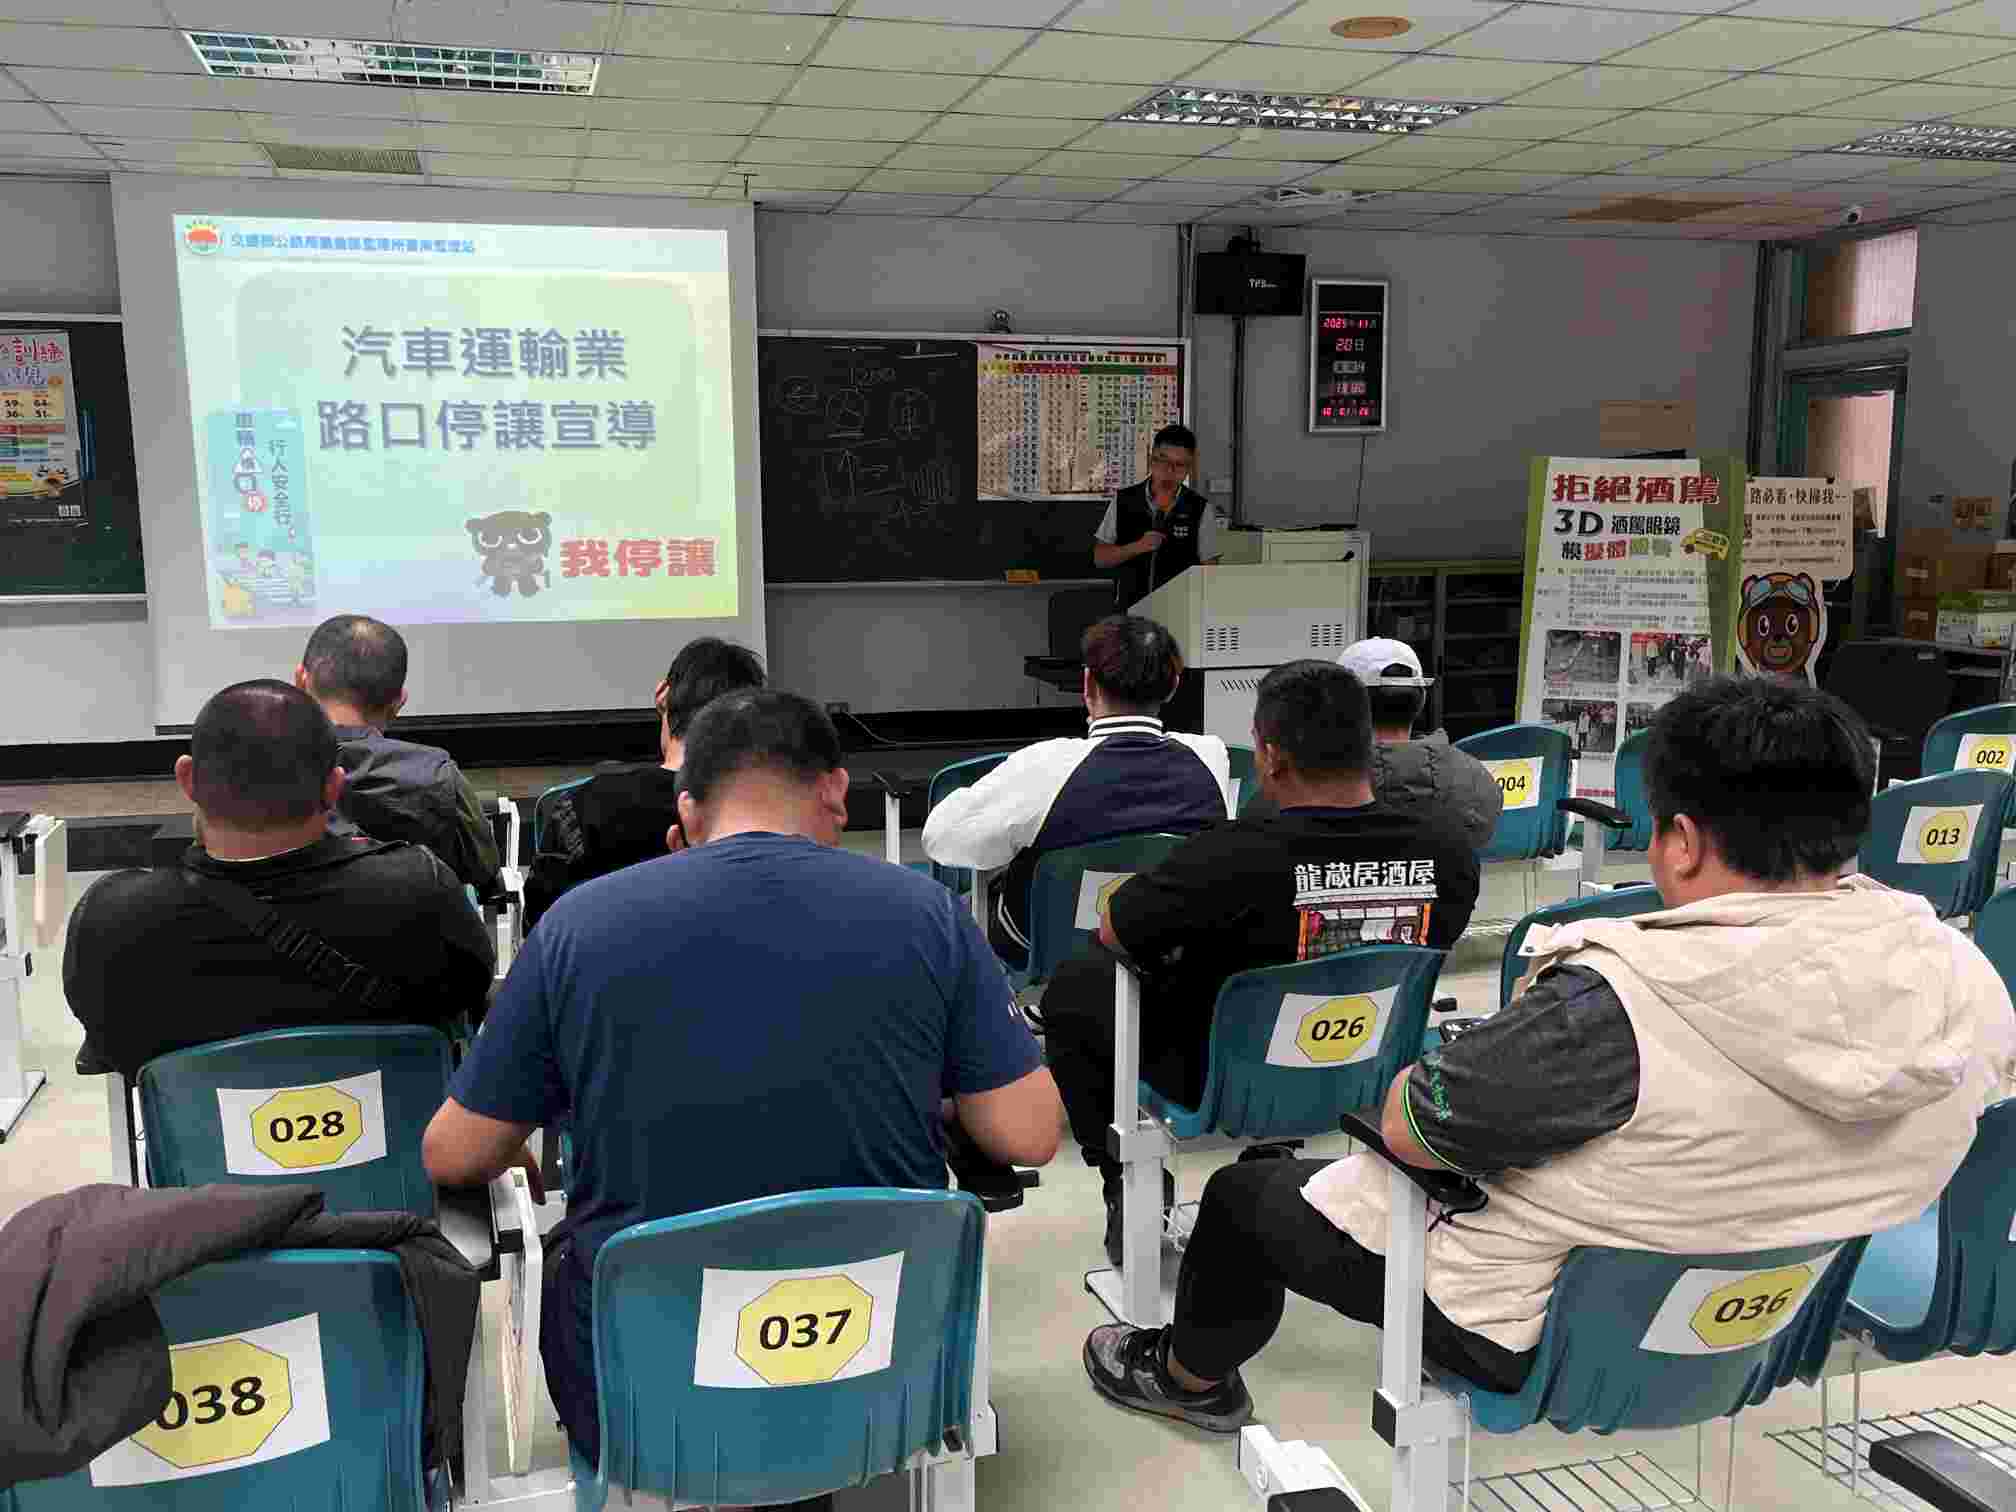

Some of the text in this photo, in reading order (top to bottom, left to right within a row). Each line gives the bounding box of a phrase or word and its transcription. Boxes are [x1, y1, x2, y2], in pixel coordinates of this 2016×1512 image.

[341, 325, 627, 379] 汽車運輸業
[317, 398, 657, 450] 路口停讓宣導
[1552, 472, 1720, 505] 拒絕酒駕
[1553, 507, 1604, 537] 3D
[560, 539, 716, 578] 我停讓
[1976, 749, 2005, 765] 002
[1926, 828, 1961, 847] 013
[1311, 1016, 1366, 1042] 026
[269, 1110, 345, 1143] 028
[1714, 1287, 1793, 1323] 036
[759, 1308, 852, 1350] 037
[157, 1376, 266, 1431] 038
